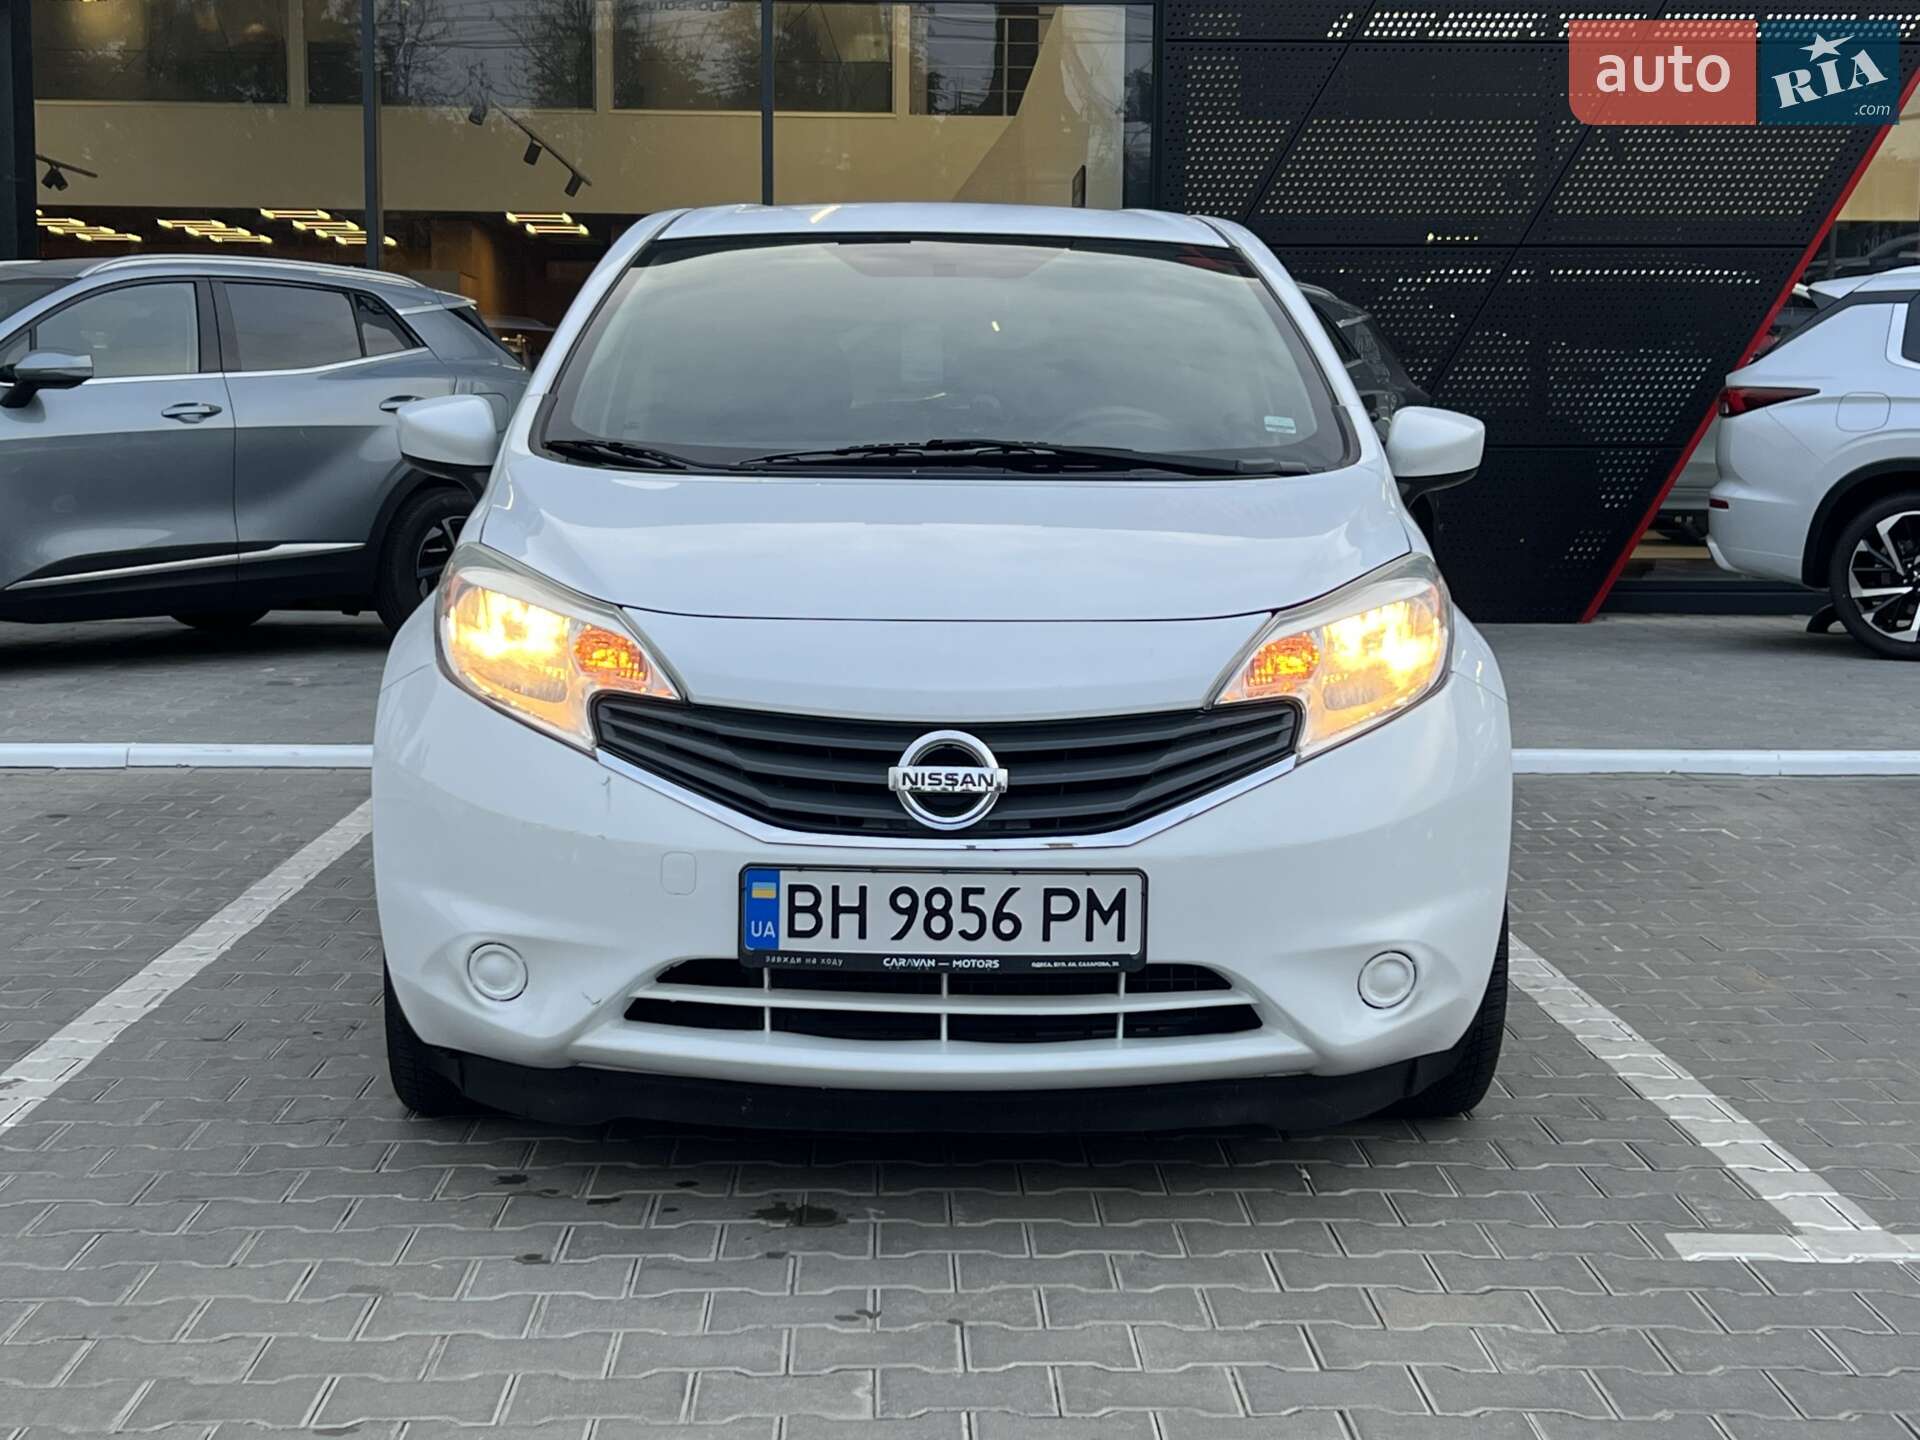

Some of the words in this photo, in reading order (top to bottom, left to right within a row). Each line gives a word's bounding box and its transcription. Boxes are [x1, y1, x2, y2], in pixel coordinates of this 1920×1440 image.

[902, 772, 994, 787] NISSAN
[786, 884, 868, 940] BH
[888, 886, 1023, 941] 9856
[1041, 887, 1127, 942] PM
[750, 921, 776, 938] UA
[883, 957, 936, 967] CARAVAN
[952, 959, 1000, 969] MOTORS
